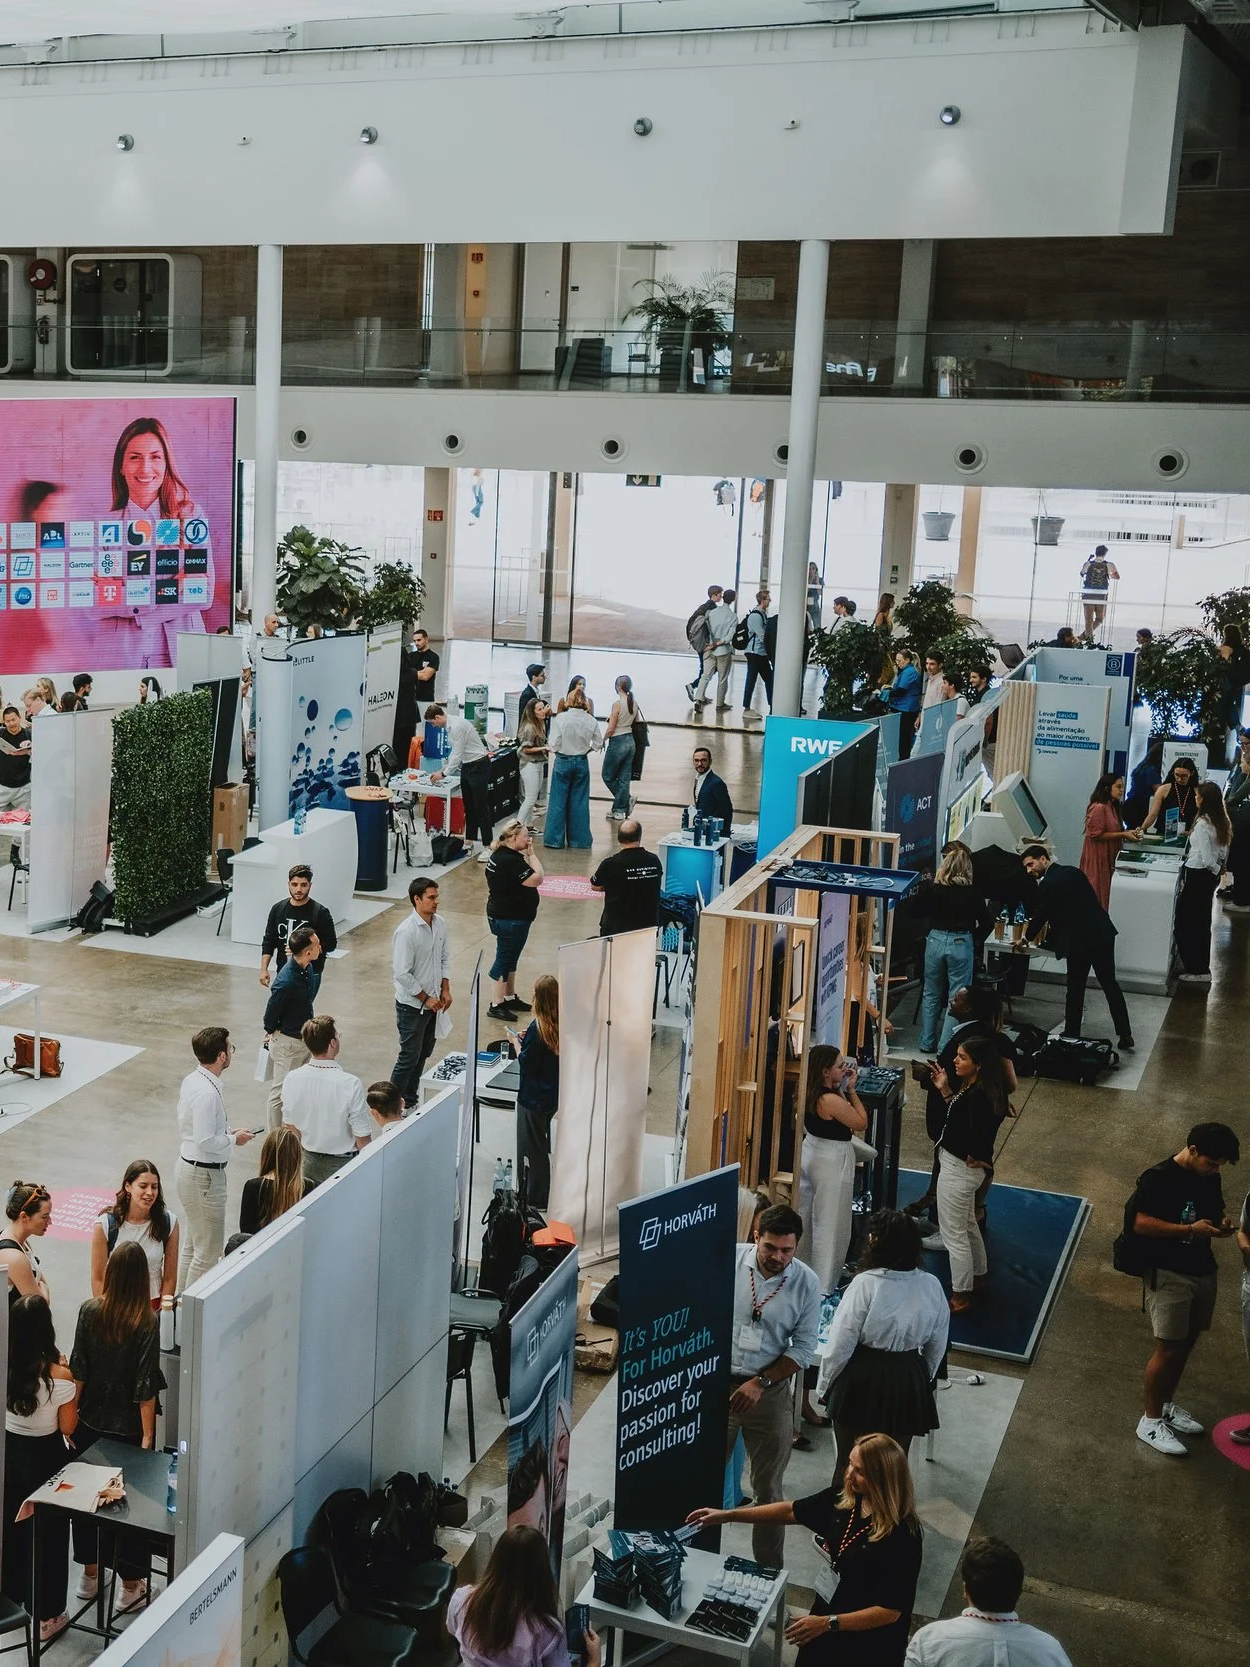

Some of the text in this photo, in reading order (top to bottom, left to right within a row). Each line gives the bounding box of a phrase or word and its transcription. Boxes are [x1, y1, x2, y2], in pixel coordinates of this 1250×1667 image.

[131, 562, 145, 572] EY
[368, 690, 395, 706] HALEON
[1046, 726, 1085, 734] alimentação
[1072, 741, 1098, 749] possível
[916, 796, 932, 812] ACT
[905, 842, 915, 852] the
[664, 1202, 717, 1236] HORVÁTH
[652, 1306, 690, 1342] YOU!
[622, 1356, 647, 1384] For
[650, 1327, 714, 1374] Horváth.
[621, 1353, 720, 1413] Discover your
[619, 1388, 702, 1448] passion for
[618, 1412, 701, 1471] consulting!
[189, 1566, 238, 1626] BERTELSMANN
